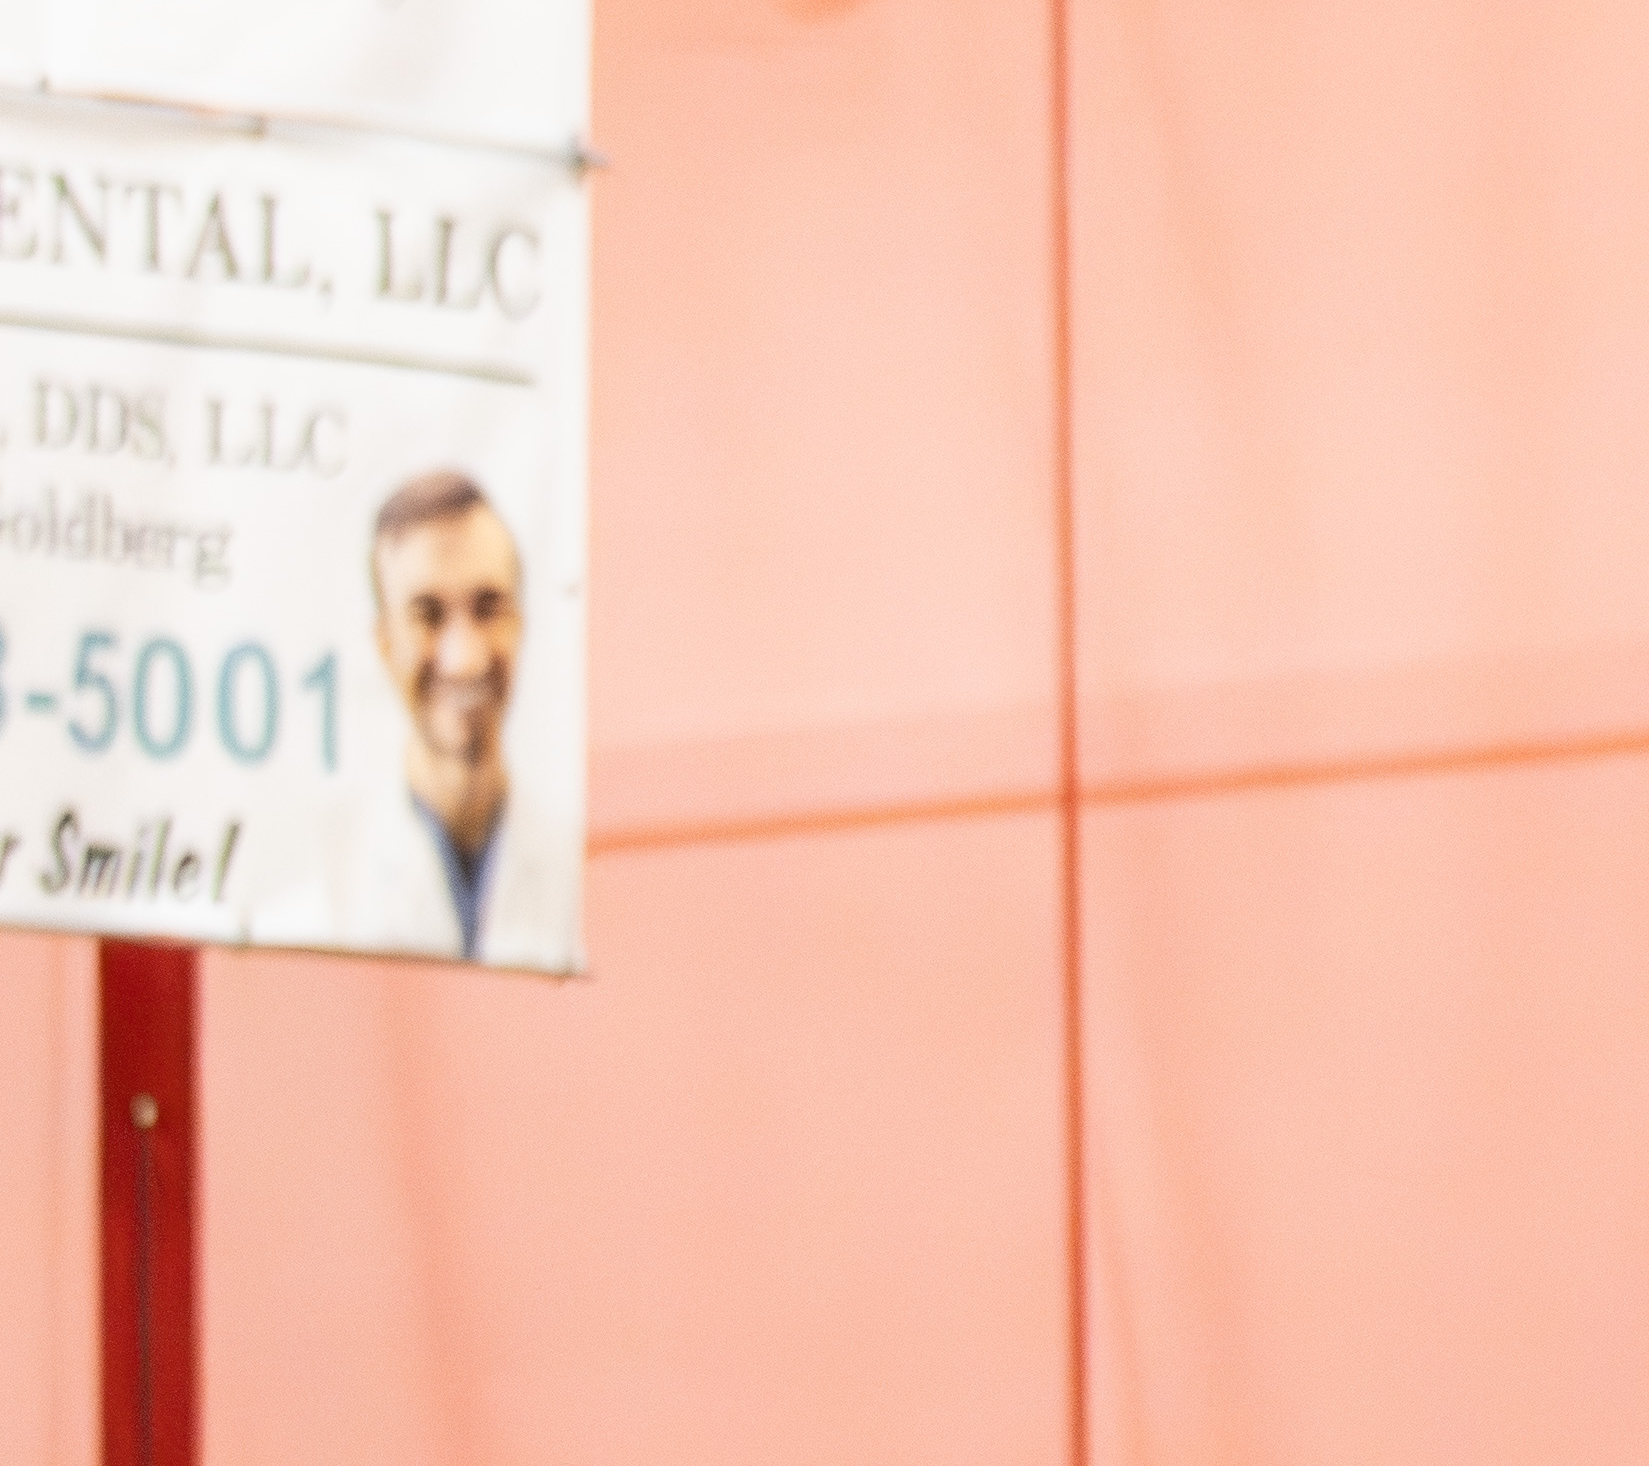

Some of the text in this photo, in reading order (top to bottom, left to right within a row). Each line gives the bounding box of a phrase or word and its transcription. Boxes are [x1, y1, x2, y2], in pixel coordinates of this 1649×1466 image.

[370, 204, 545, 324] LLC
[206, 394, 352, 480] LLC
[40, 806, 246, 910] Smile!
